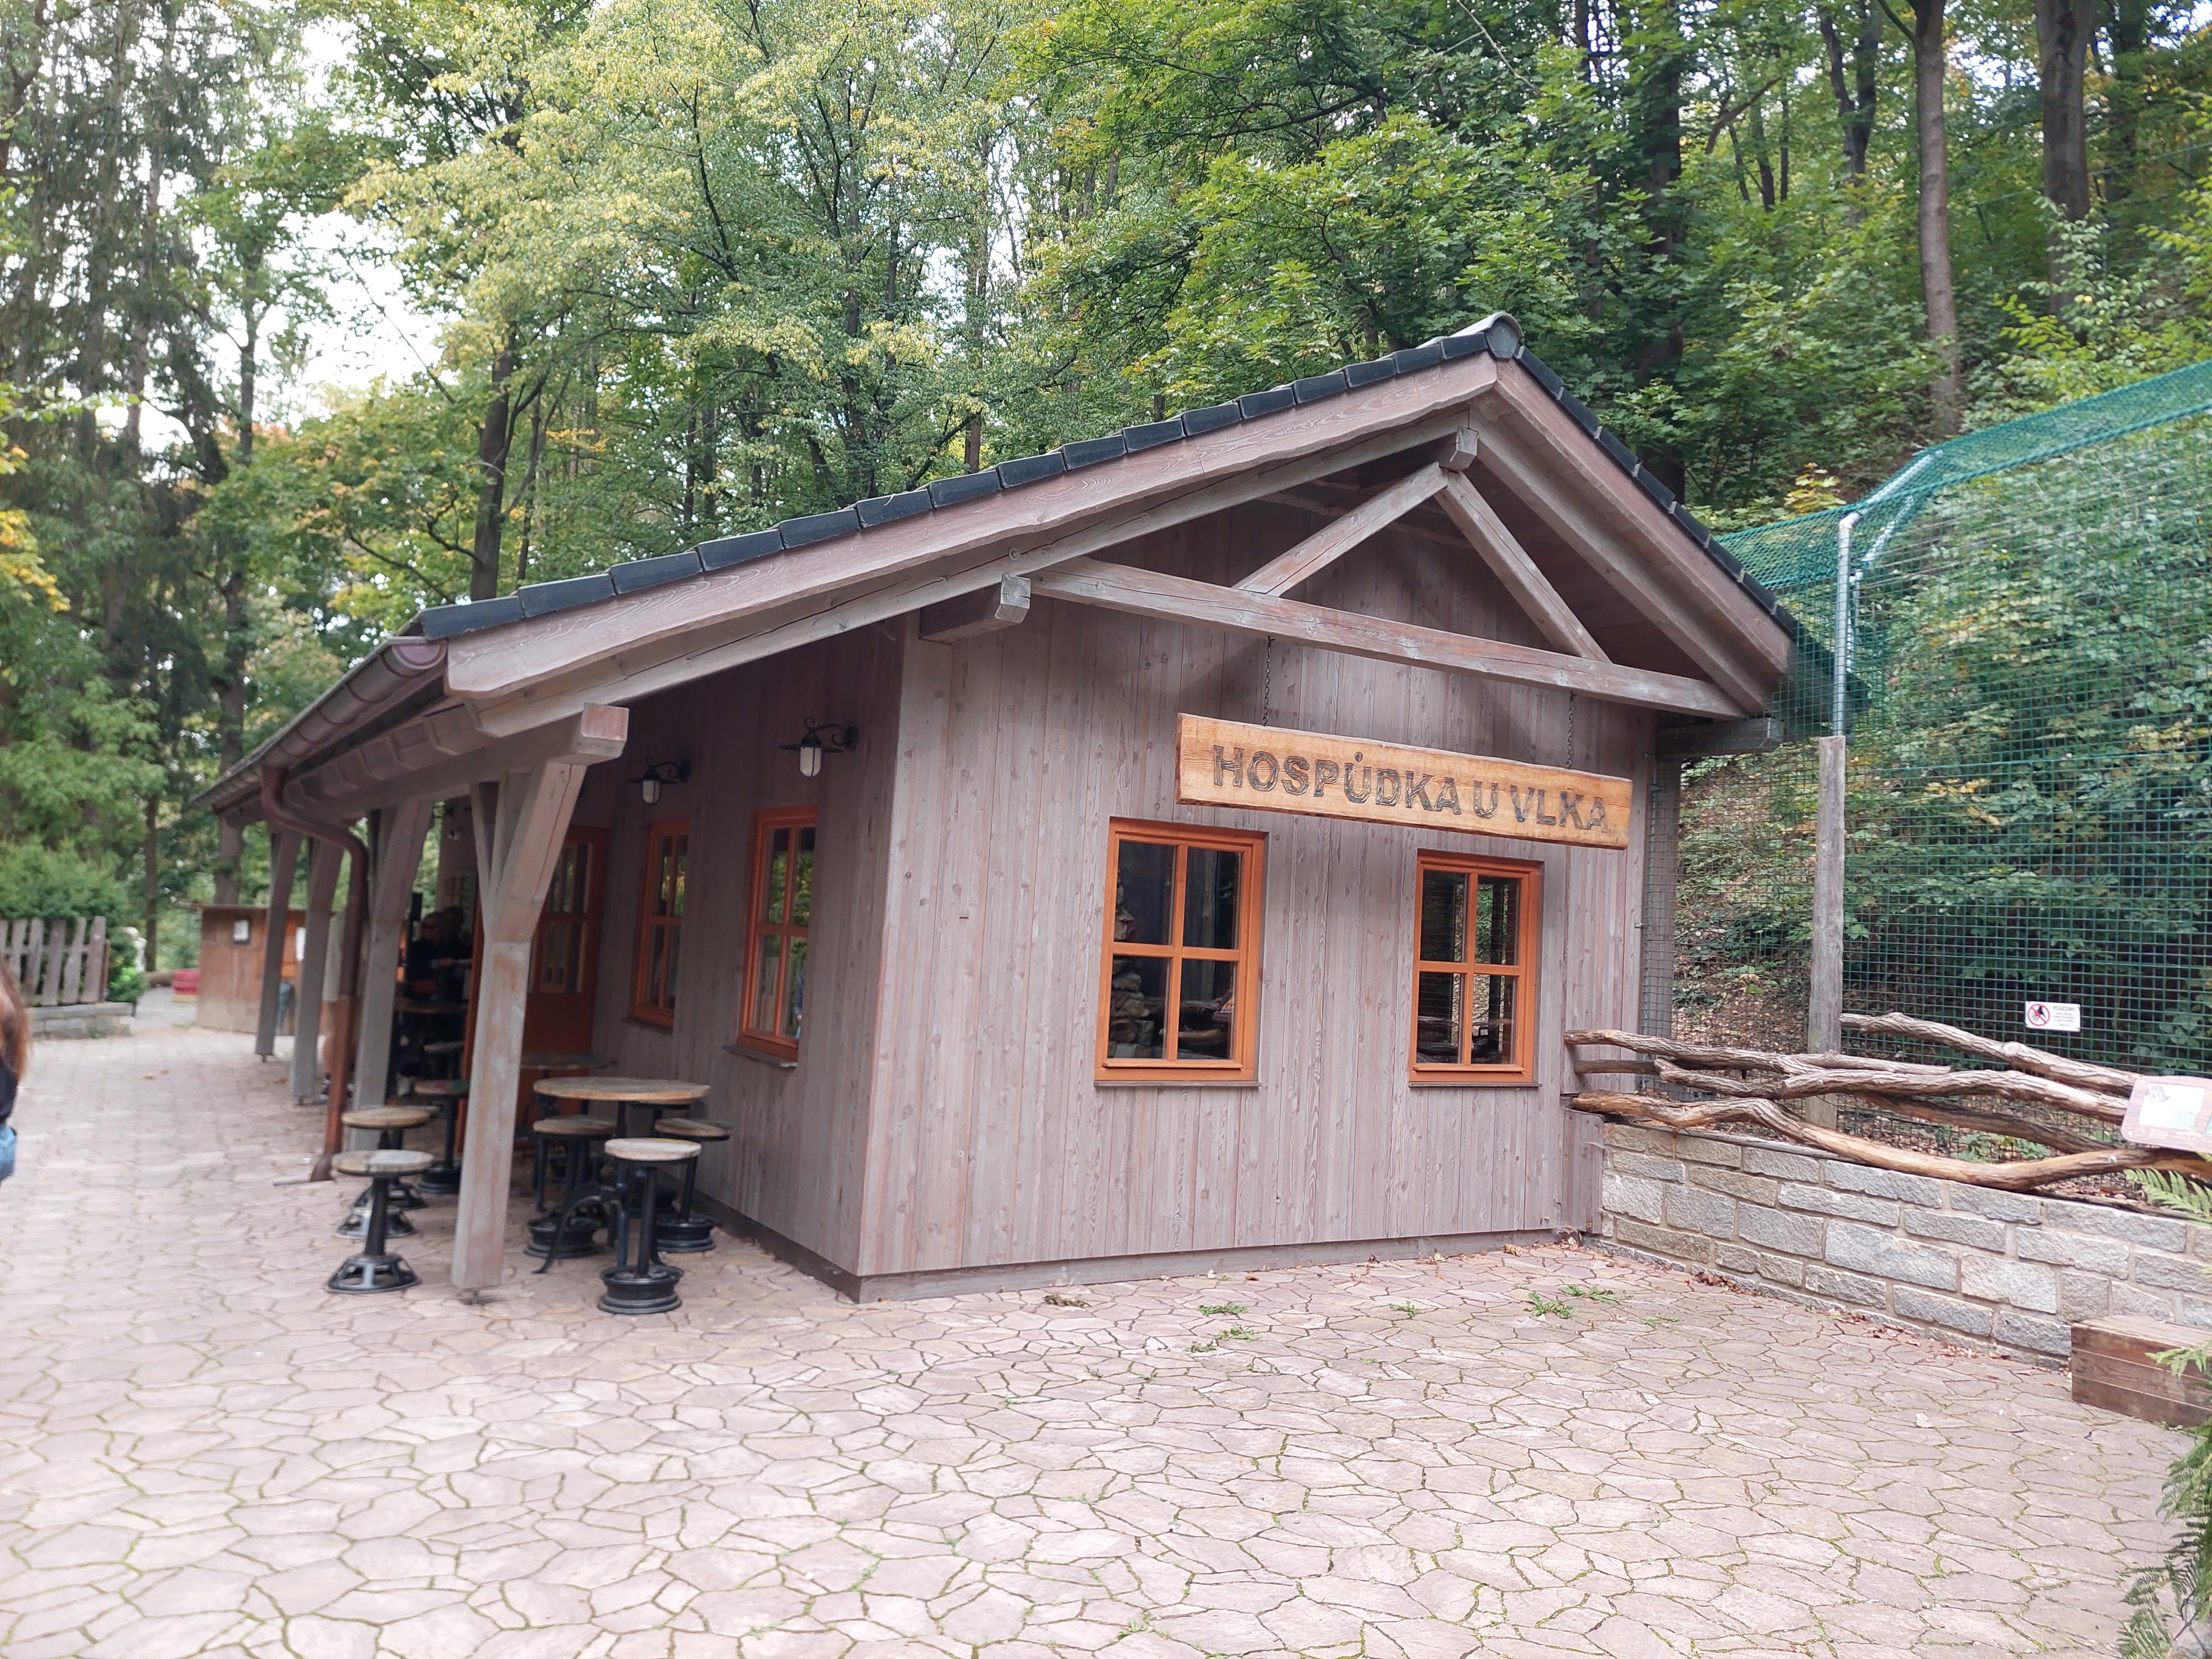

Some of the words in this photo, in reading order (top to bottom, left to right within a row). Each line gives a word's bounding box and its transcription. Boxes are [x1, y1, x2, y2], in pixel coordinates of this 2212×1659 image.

[1213, 744, 1462, 816] HOSPŮDKA
[1473, 780, 1499, 820] U
[1510, 784, 1608, 833] VLKA
